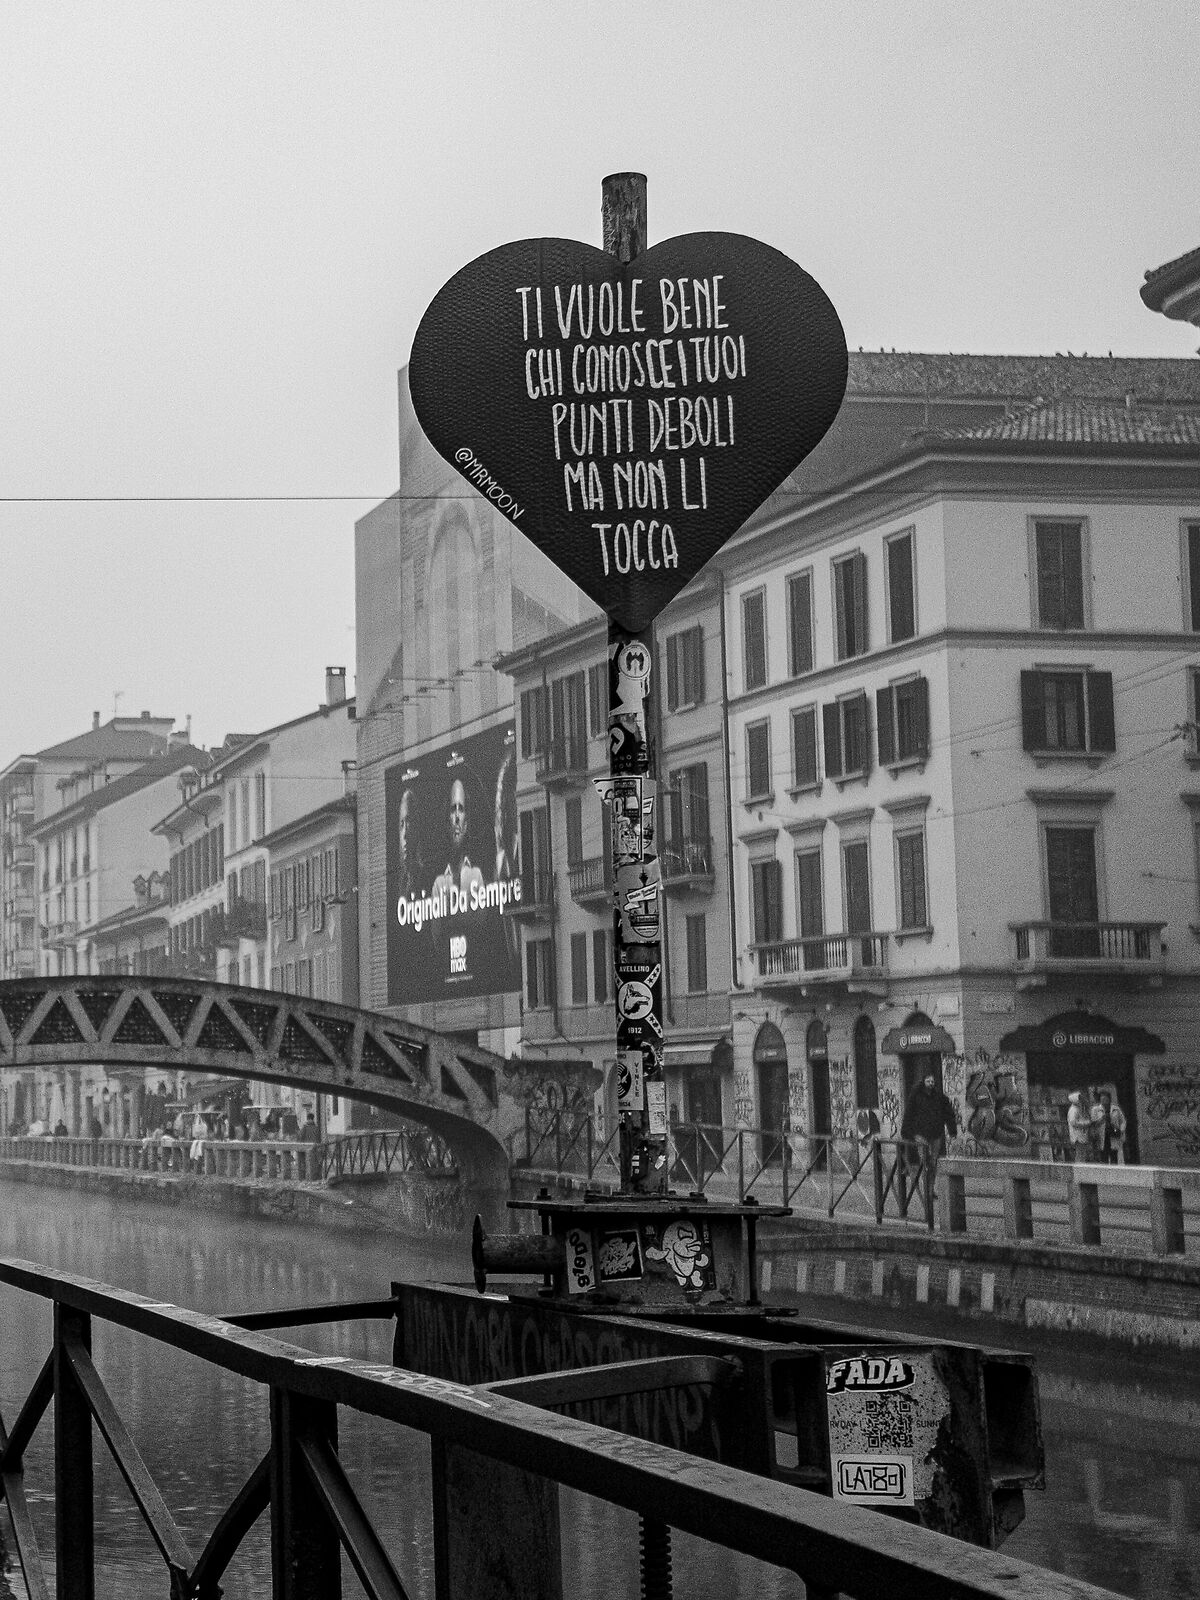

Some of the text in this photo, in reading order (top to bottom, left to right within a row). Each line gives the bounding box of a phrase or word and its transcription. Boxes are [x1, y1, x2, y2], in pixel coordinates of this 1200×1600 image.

[515, 275, 730, 341] TI VUOLE BENE
[525, 334, 747, 400] CHI CONOSCE I TUOI
[552, 394, 735, 460] PUNTI DEBOLI
[454, 446, 525, 522] @MRMOON
[563, 456, 708, 512] MA NON LI
[591, 519, 679, 576] TOCCA
[397, 877, 522, 933] Originali Da Sempre
[449, 935, 467, 960] HBO
[450, 957, 467, 974] max
[619, 965, 650, 973] AVELLINO
[627, 1026, 643, 1034] 1912
[1069, 1034, 1114, 1045] LIBRACCIO
[827, 1358, 906, 1389] FADA
